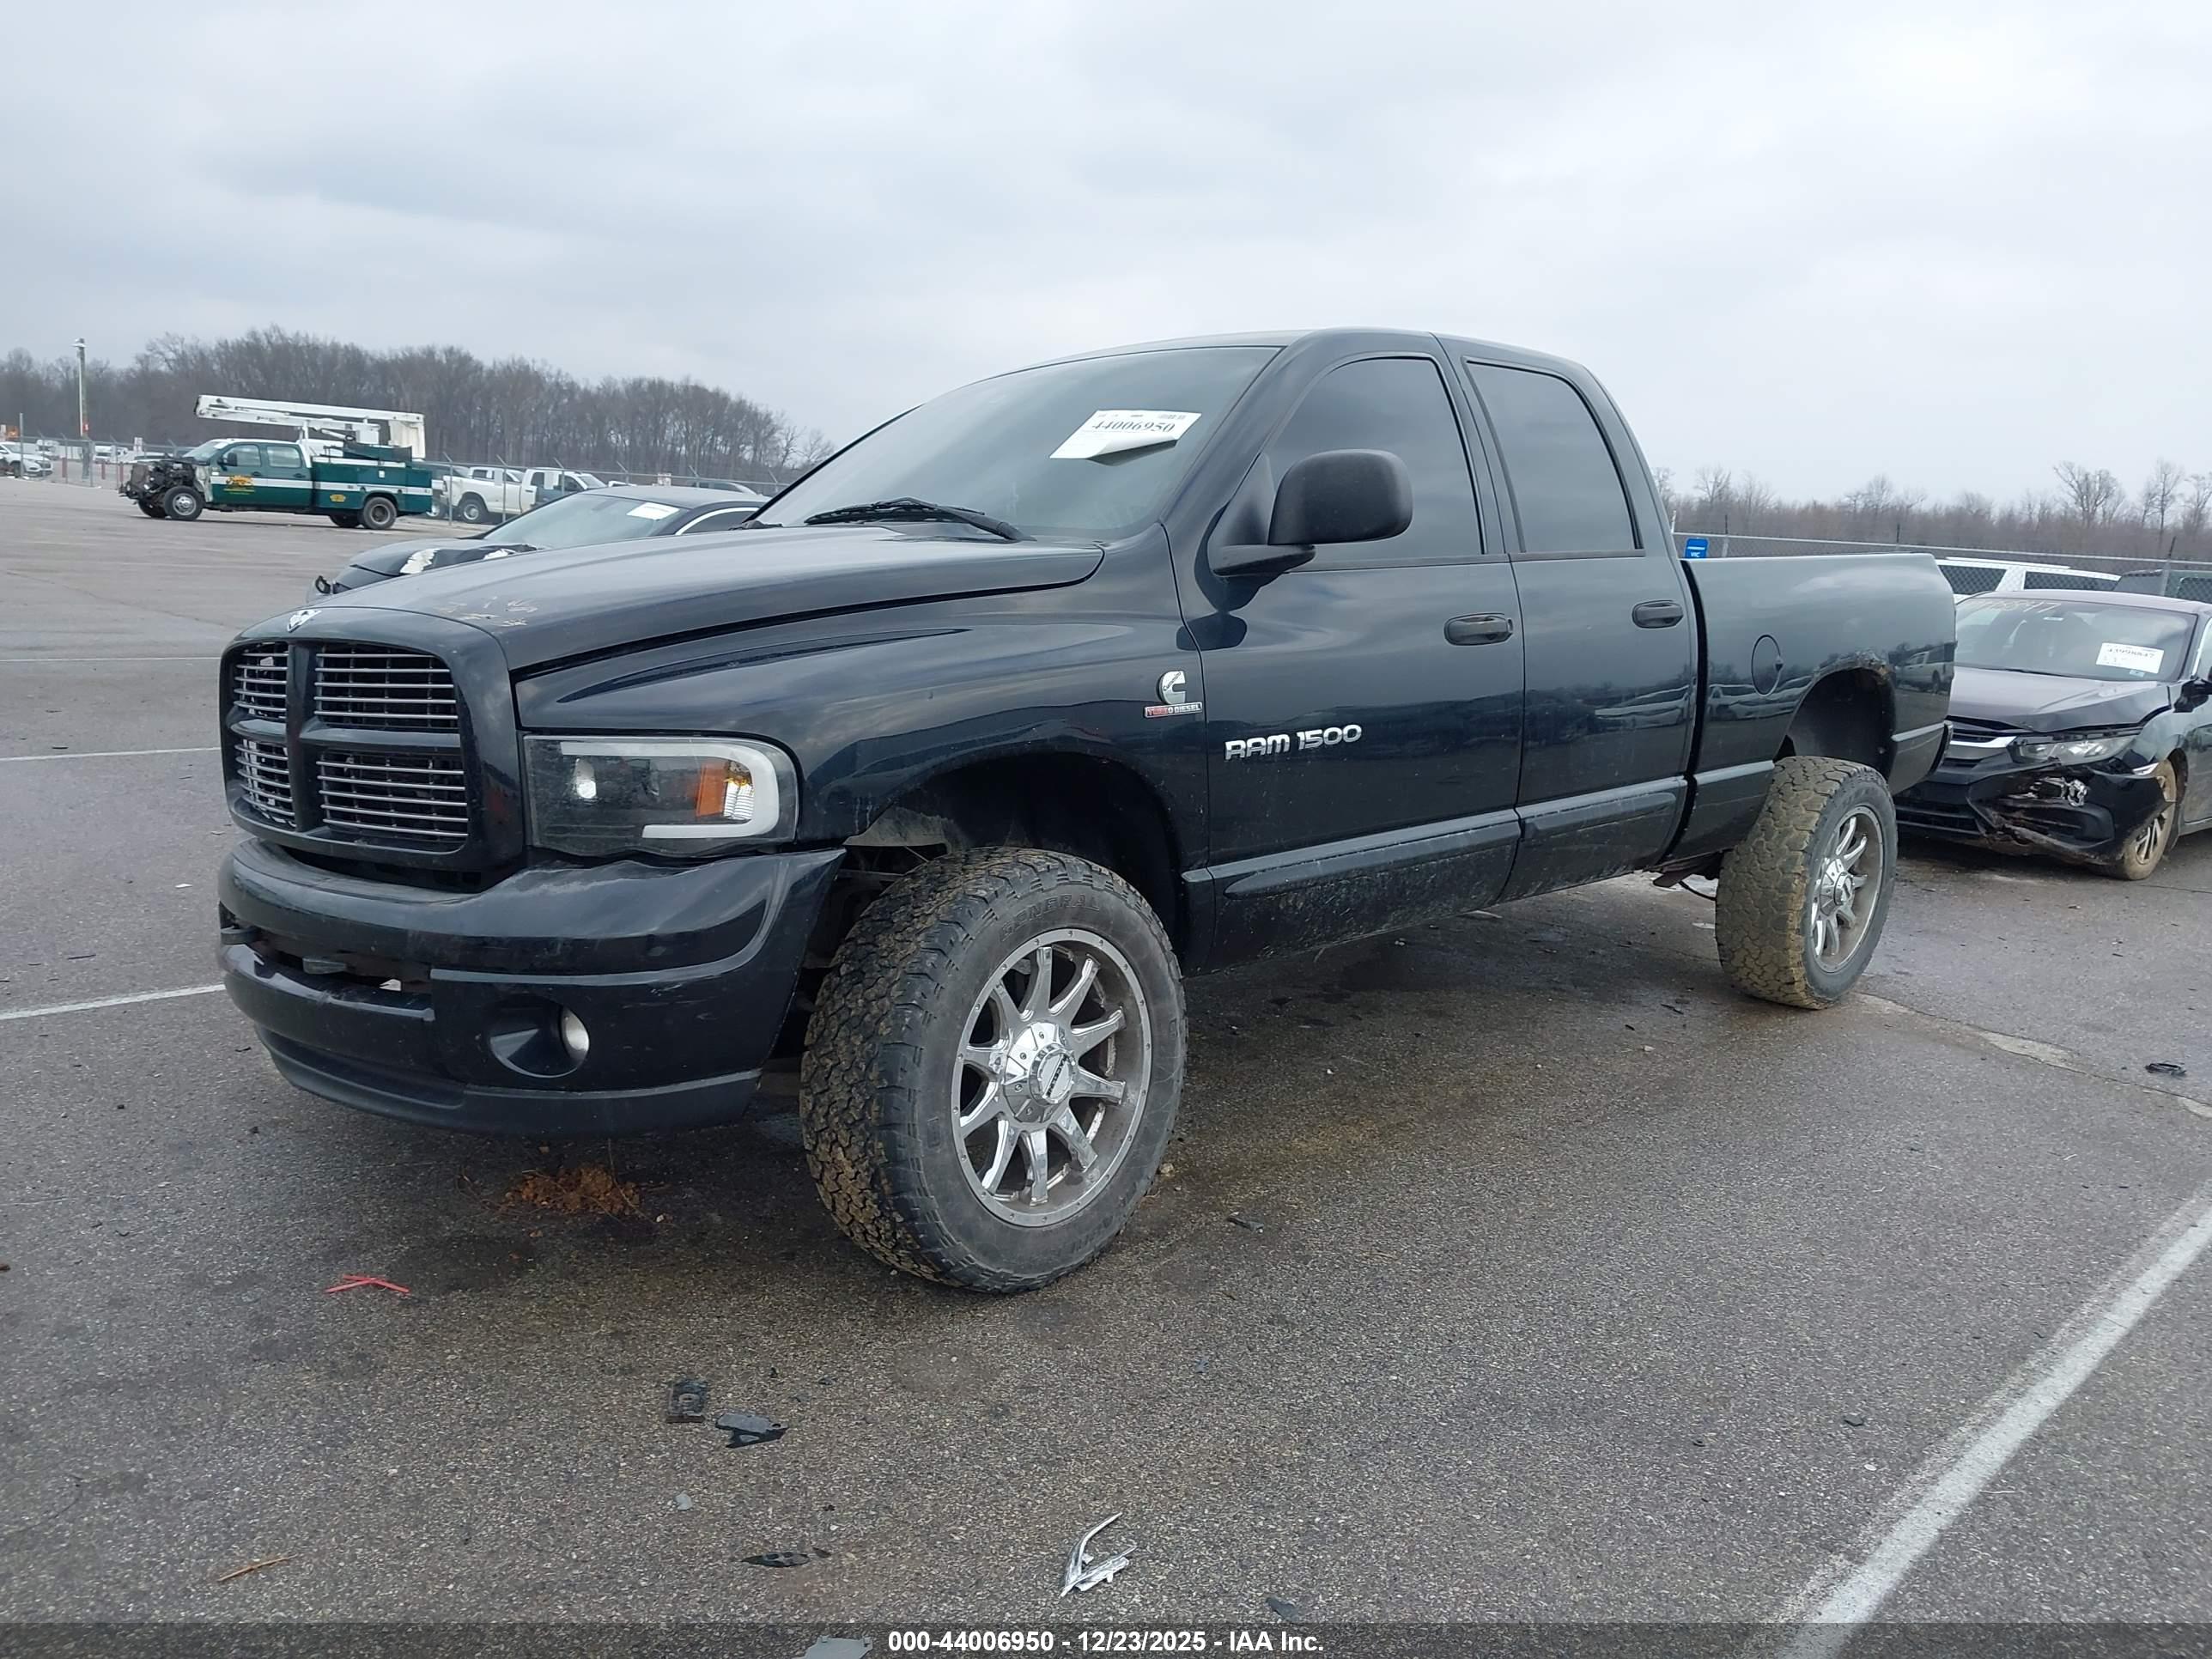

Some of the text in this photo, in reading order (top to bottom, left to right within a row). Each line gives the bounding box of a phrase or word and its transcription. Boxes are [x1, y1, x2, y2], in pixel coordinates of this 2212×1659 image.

[1091, 421, 1176, 432] 44006950
[1225, 724, 1363, 760] RAM 1500
